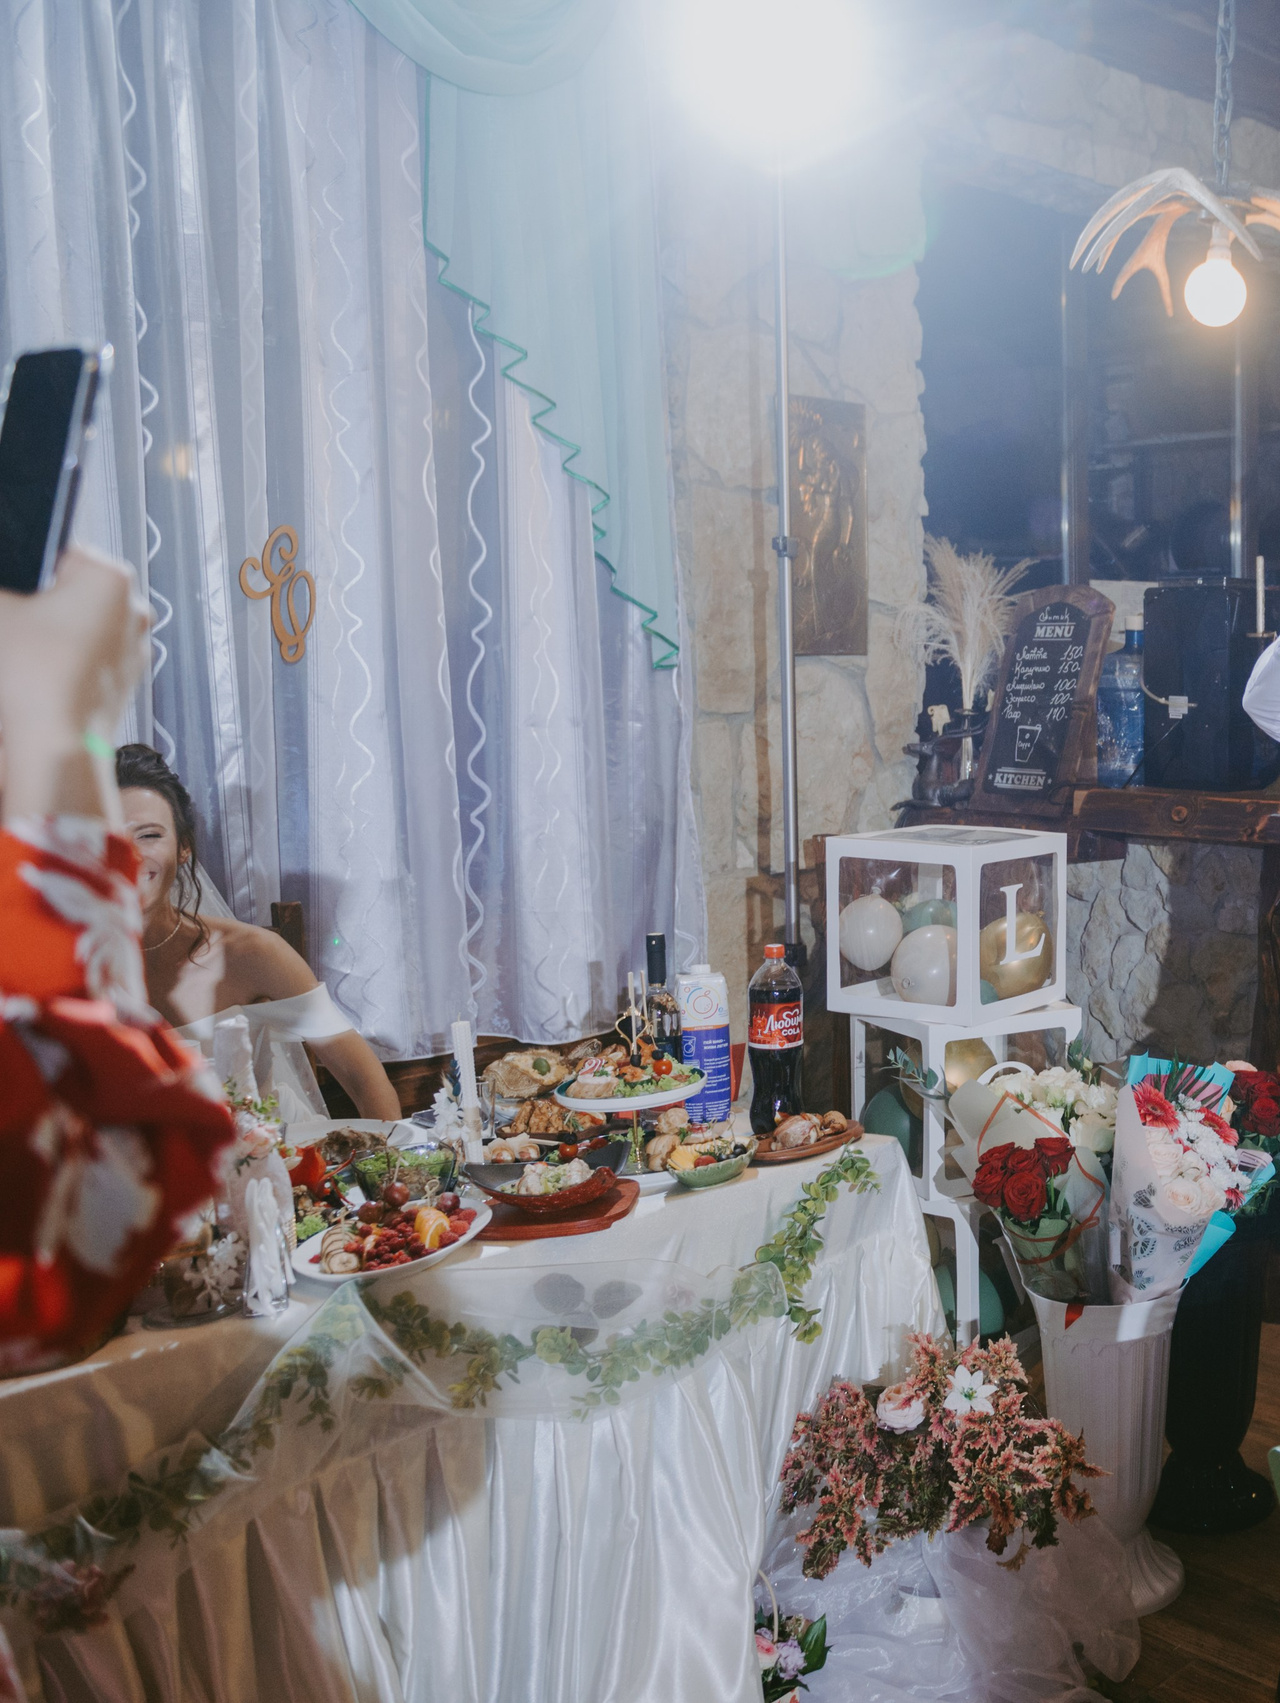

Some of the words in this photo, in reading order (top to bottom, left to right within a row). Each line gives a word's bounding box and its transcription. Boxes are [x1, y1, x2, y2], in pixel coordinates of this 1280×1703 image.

[1034, 625, 1075, 638] MENU
[994, 772, 1046, 787] KITCHEN
[1000, 883, 1045, 965] L
